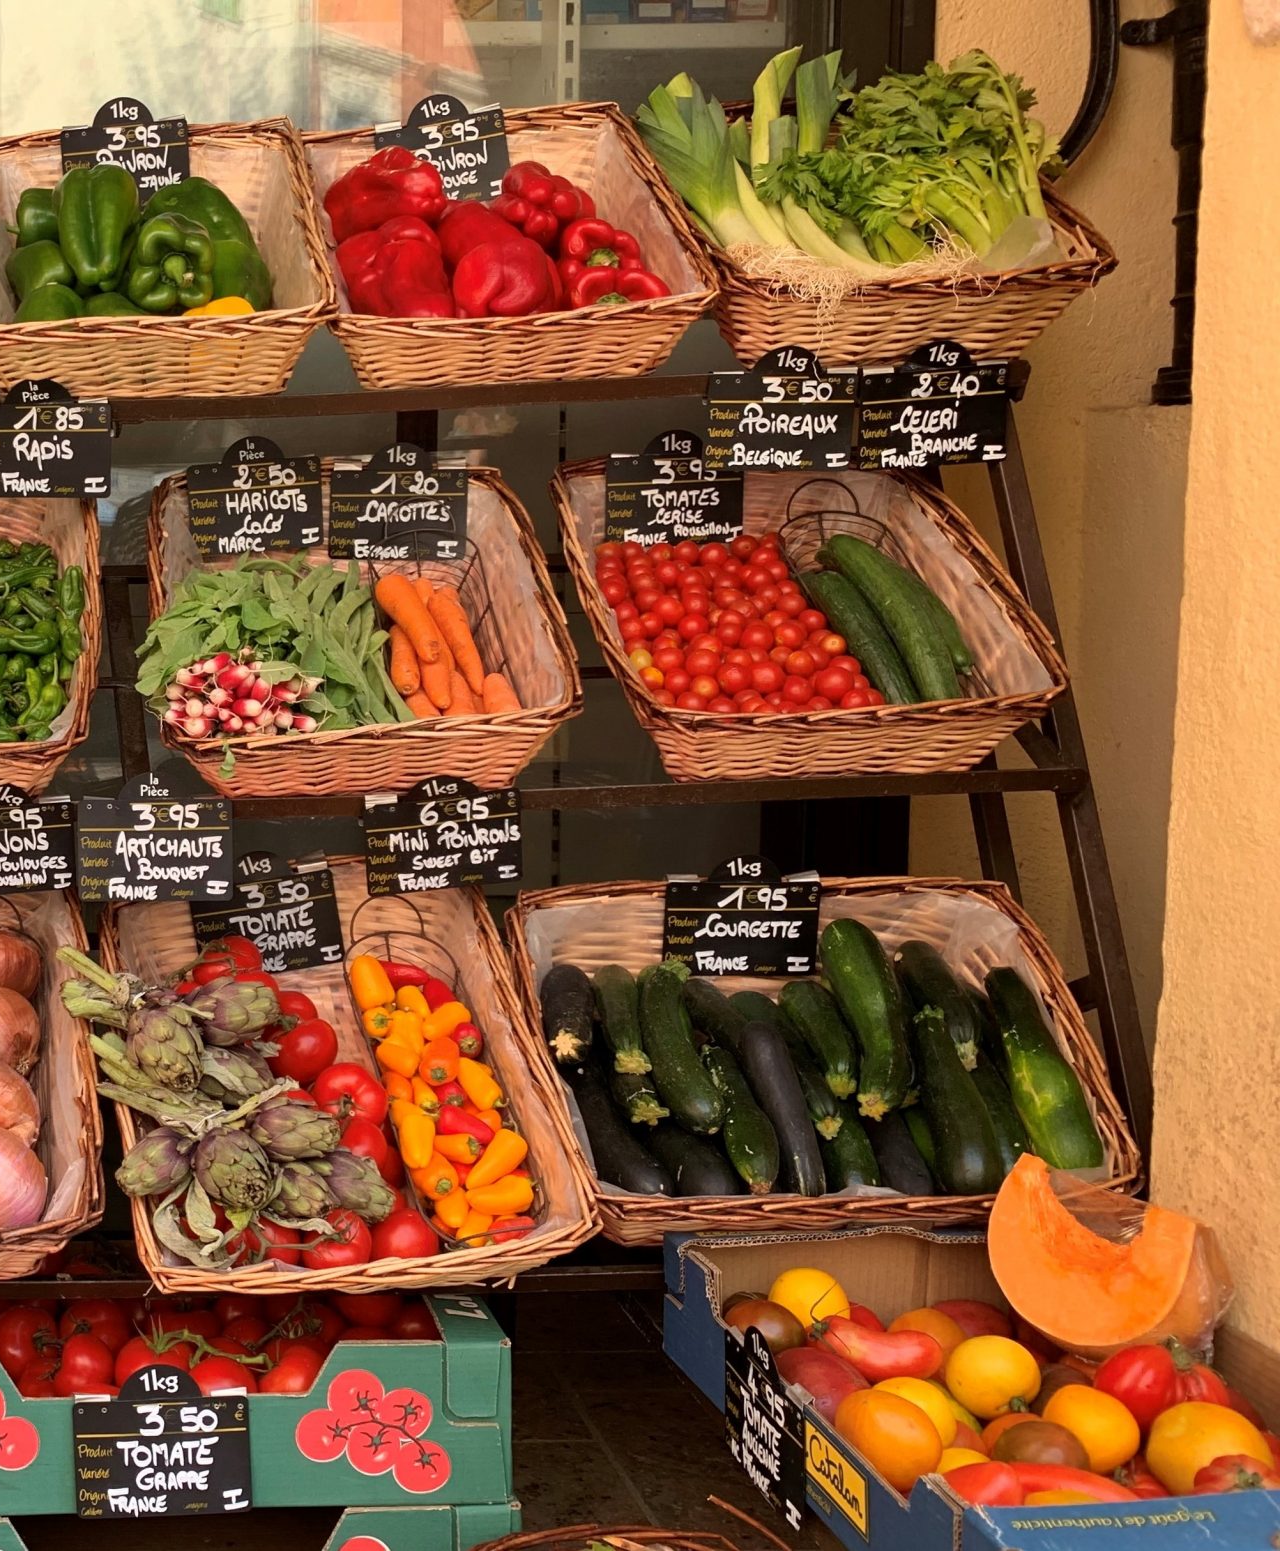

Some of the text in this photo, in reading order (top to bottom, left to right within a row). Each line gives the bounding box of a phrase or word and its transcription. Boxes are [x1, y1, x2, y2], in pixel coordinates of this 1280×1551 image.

[110, 101, 138, 120] 1kg
[421, 100, 450, 118] 1kg
[139, 166, 182, 191] JAUNE
[777, 350, 808, 372] 1kg
[929, 345, 960, 365] 1kg
[22, 390, 50, 402] Pièce
[29, 381, 38, 392] la
[738, 402, 838, 440] POIREAUX
[12, 432, 74, 471] RADIS
[246, 439, 255, 450] la
[661, 433, 692, 453] 1kg
[908, 434, 978, 454] BRANCHE
[239, 450, 264, 461] Pièce
[386, 446, 417, 465] 1kg
[881, 448, 928, 469] FRANCE
[1, 472, 51, 496] FRANCE
[225, 488, 308, 515] HARICOTS
[640, 487, 720, 508] TOMATES
[357, 499, 450, 523] CAROTTES
[647, 507, 704, 526] CERISE
[218, 537, 266, 554] MAROC
[623, 528, 668, 546] FRANCE
[354, 539, 410, 558] ESPAGNE
[150, 773, 159, 785] la
[422, 780, 458, 797] 1kg
[140, 785, 168, 797] Pièce
[437, 818, 520, 849] POIVRONS
[81, 831, 223, 872] Produit ARTICHAUTS
[412, 848, 499, 870] SWEET BIT
[137, 858, 209, 881] BOUQUET
[238, 856, 272, 875] 1kg
[726, 858, 762, 877] 1kg
[108, 877, 158, 900] FRANCE
[397, 872, 449, 891] FRANCE
[229, 901, 314, 936] TOMATE
[694, 913, 803, 938] COURGETTE
[252, 928, 316, 954] GRAPPE
[695, 950, 749, 976] FRANCE
[752, 1333, 769, 1370] 1kg
[139, 1369, 178, 1393] 1kg
[740, 1386, 781, 1458] TOMATE
[78, 1436, 219, 1467] Produit TOMATE
[78, 1468, 210, 1491] Variété GRAPPE
[742, 1443, 770, 1497] FRANCE
[810, 1434, 863, 1519] Catalan
[107, 1488, 168, 1518] FRANCE
[1125, 1516, 1145, 1527] de
